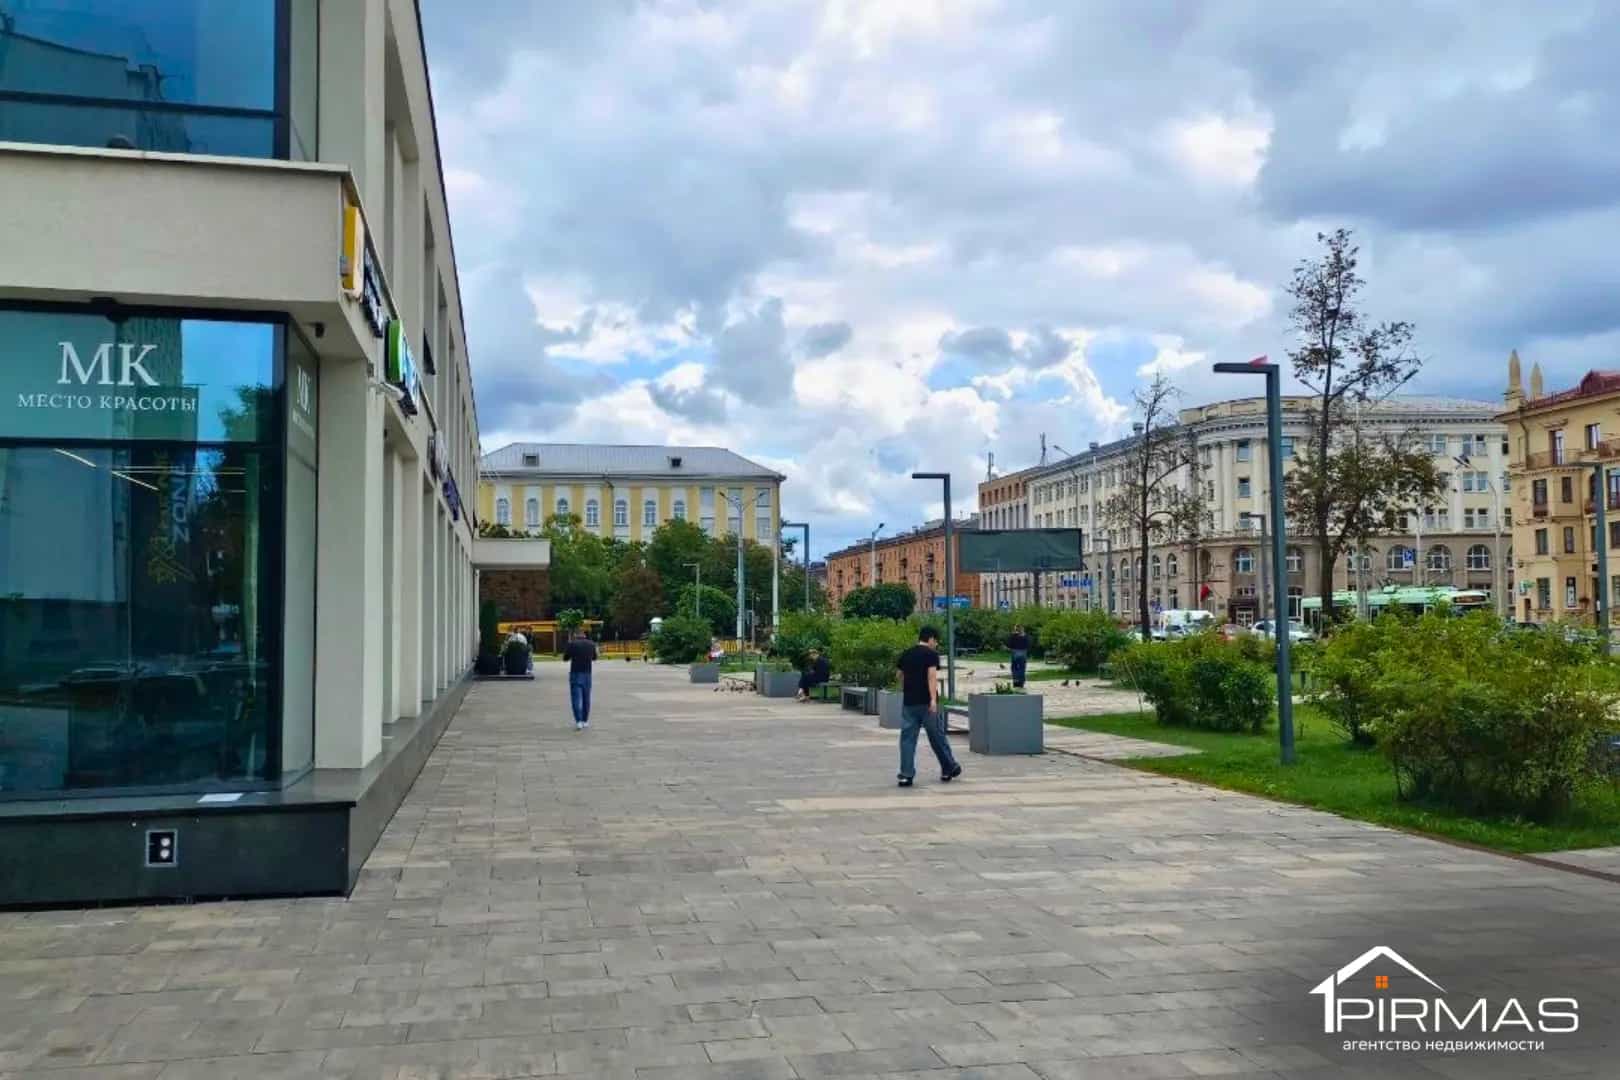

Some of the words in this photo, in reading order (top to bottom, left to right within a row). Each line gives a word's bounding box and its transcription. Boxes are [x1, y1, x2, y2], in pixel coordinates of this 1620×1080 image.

[57, 341, 160, 386] МК
[18, 393, 92, 408] МЕСТО
[100, 395, 196, 411] КРАСОТЫ
